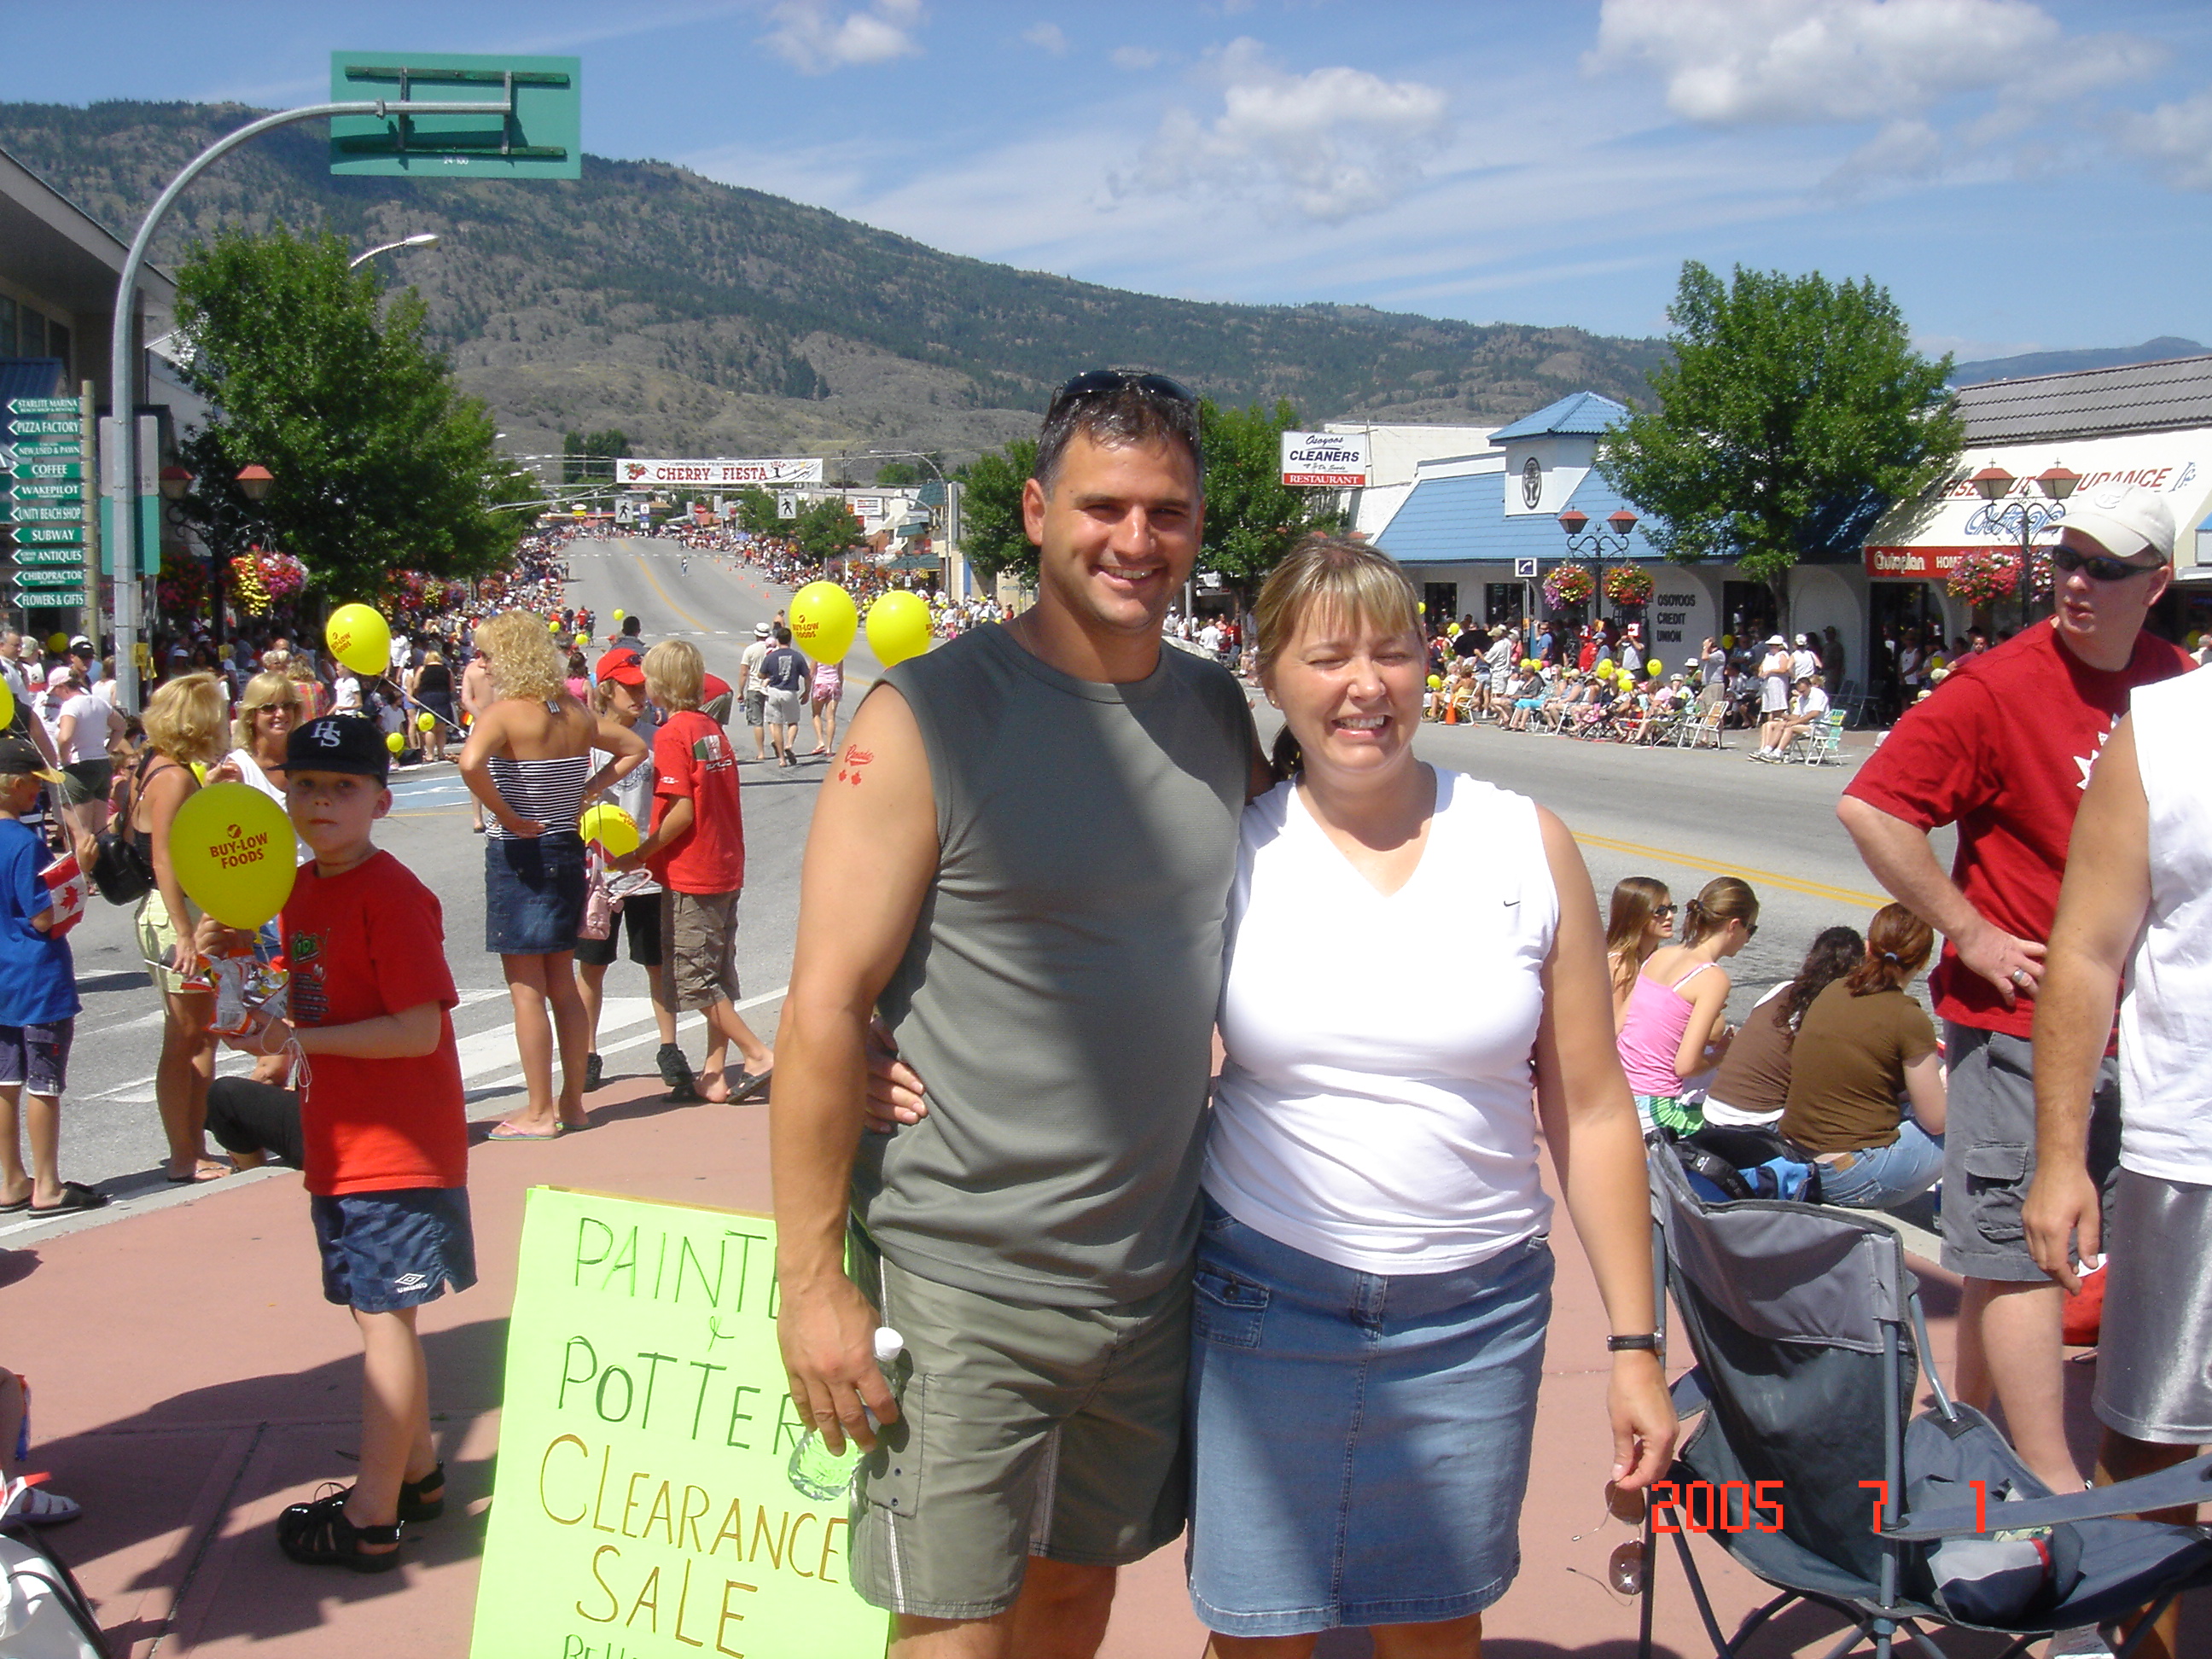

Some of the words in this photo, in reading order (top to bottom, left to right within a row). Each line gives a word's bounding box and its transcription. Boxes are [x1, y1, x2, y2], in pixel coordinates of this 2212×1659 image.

[18, 399, 47, 408] STARLITE
[17, 422, 40, 433] PIZZA
[42, 422, 78, 433] FACTORY
[1305, 434, 1343, 446] Osoyoos
[60, 445, 80, 454] PAWN
[1289, 451, 1359, 462] CLEANERS
[32, 464, 68, 474] COFFEE
[656, 467, 710, 480] CHERRY
[722, 467, 767, 480] FIESTA
[1289, 474, 1359, 485] RESTAURANT
[2076, 468, 2174, 492] URANCE
[21, 485, 79, 494] WAKEPILOT
[19, 508, 38, 520] UNITY
[40, 508, 61, 520] BEACH
[63, 507, 81, 520] SHOP
[32, 530, 74, 541] SUBWAY
[38, 550, 82, 562] ANTIQUES
[1874, 550, 1925, 574] Autoplan
[22, 571, 83, 580] CHIROPRACTOR
[22, 595, 55, 606] FLOWERS
[56, 594, 62, 605] &
[63, 594, 84, 605] GIFTS
[1657, 594, 1696, 607] OSOYOOS
[1656, 612, 1686, 625] CREDIT
[1656, 630, 1681, 643] UNION
[209, 831, 268, 859] BUY-LOW
[220, 847, 265, 869] FOODS
[539, 1434, 849, 1584] CLEARANCE
[576, 1544, 759, 1659] SALE
